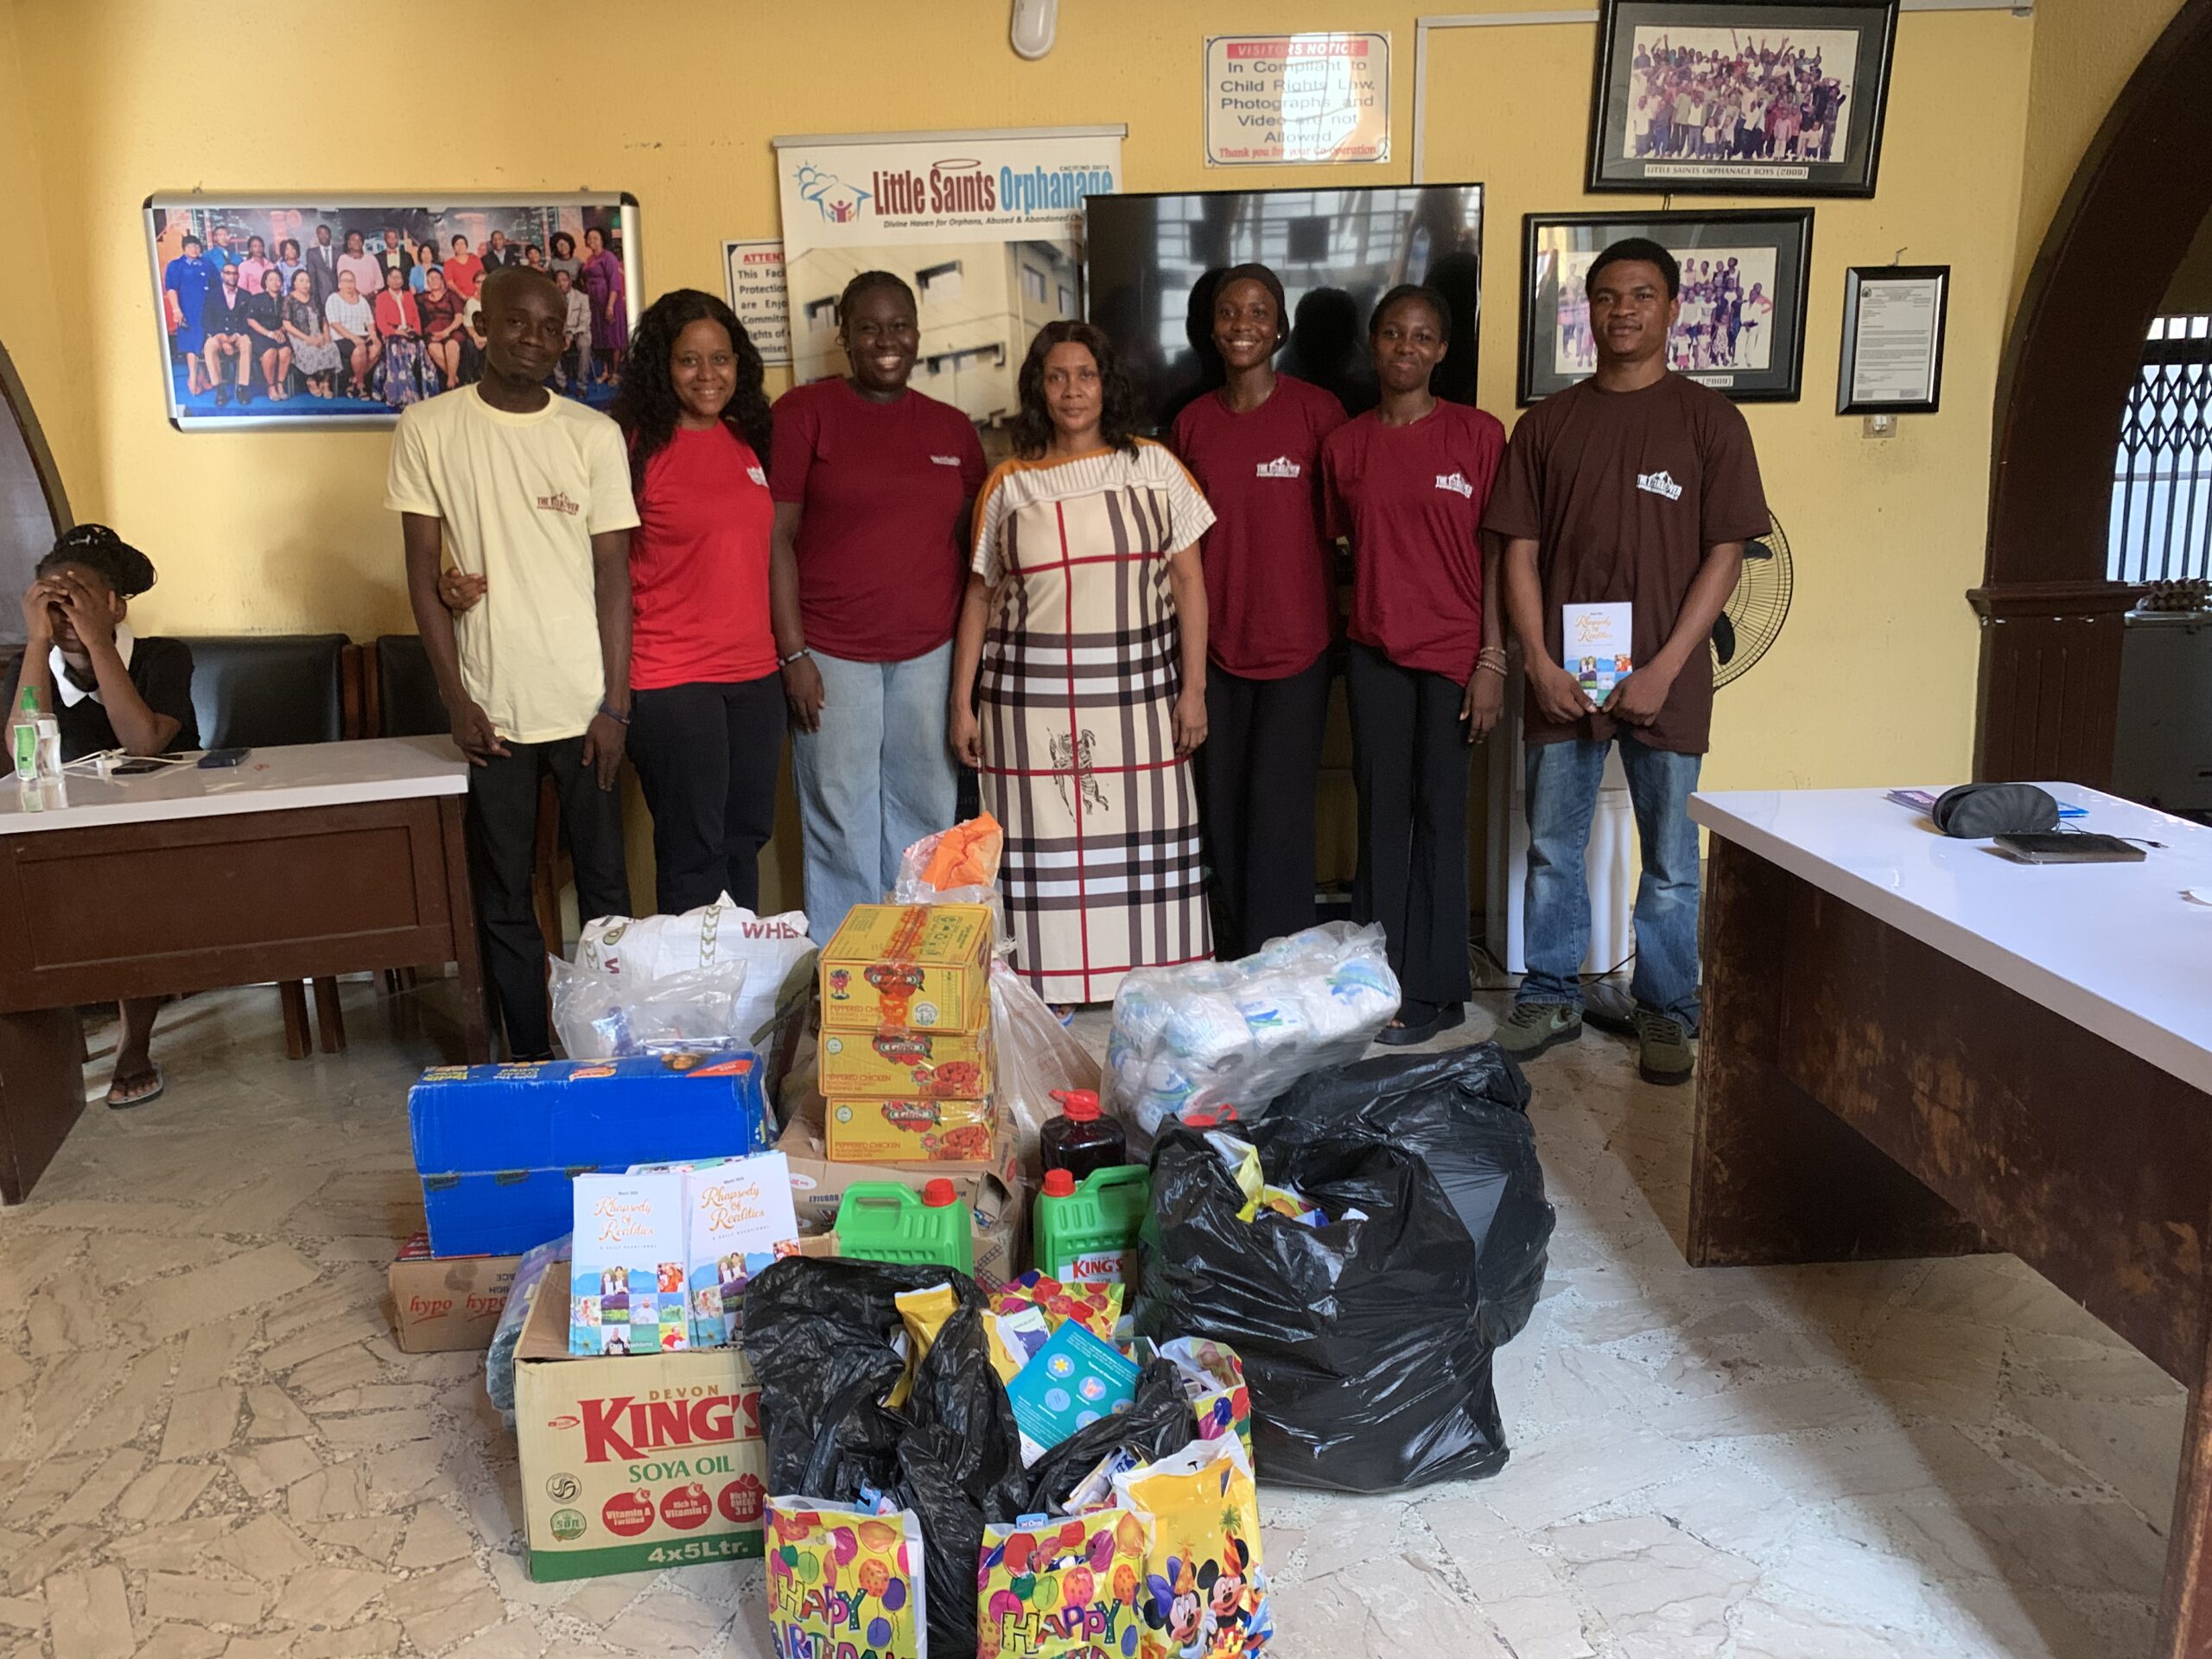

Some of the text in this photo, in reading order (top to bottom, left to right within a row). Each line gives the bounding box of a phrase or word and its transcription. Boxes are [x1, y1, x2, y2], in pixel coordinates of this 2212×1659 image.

[1238, 41, 1357, 56] VISITORS NOTICE
[1228, 61, 1243, 73] In
[1351, 60, 1367, 71] to
[1220, 80, 1264, 92] Child
[1274, 79, 1328, 92] Rights
[1237, 115, 1287, 127] Video
[1264, 130, 1332, 143] Allowed
[873, 170, 925, 215] Little
[930, 168, 995, 213] Saints
[766, 300, 788, 310] Enjo
[742, 315, 789, 325] Commitm
[748, 330, 772, 340] ights
[741, 921, 800, 939] WHE
[701, 1181, 760, 1209] Rhapsody
[594, 1196, 651, 1217] Rhapsody
[709, 1207, 765, 1231] Realities
[598, 1217, 653, 1242] Realities
[1071, 1258, 1124, 1279] KING'S
[410, 1295, 453, 1315] hypo
[649, 1384, 719, 1402] DEVON
[577, 1391, 761, 1464] KING'S
[629, 1455, 735, 1484] SOYA OIL
[607, 1508, 643, 1521] Vitamin
[664, 1505, 708, 1519] Vitamin E
[648, 1541, 748, 1563] 4x5Ltr.
[776, 1573, 868, 1639] HAPPY
[1001, 1598, 1123, 1655] HAPPY
